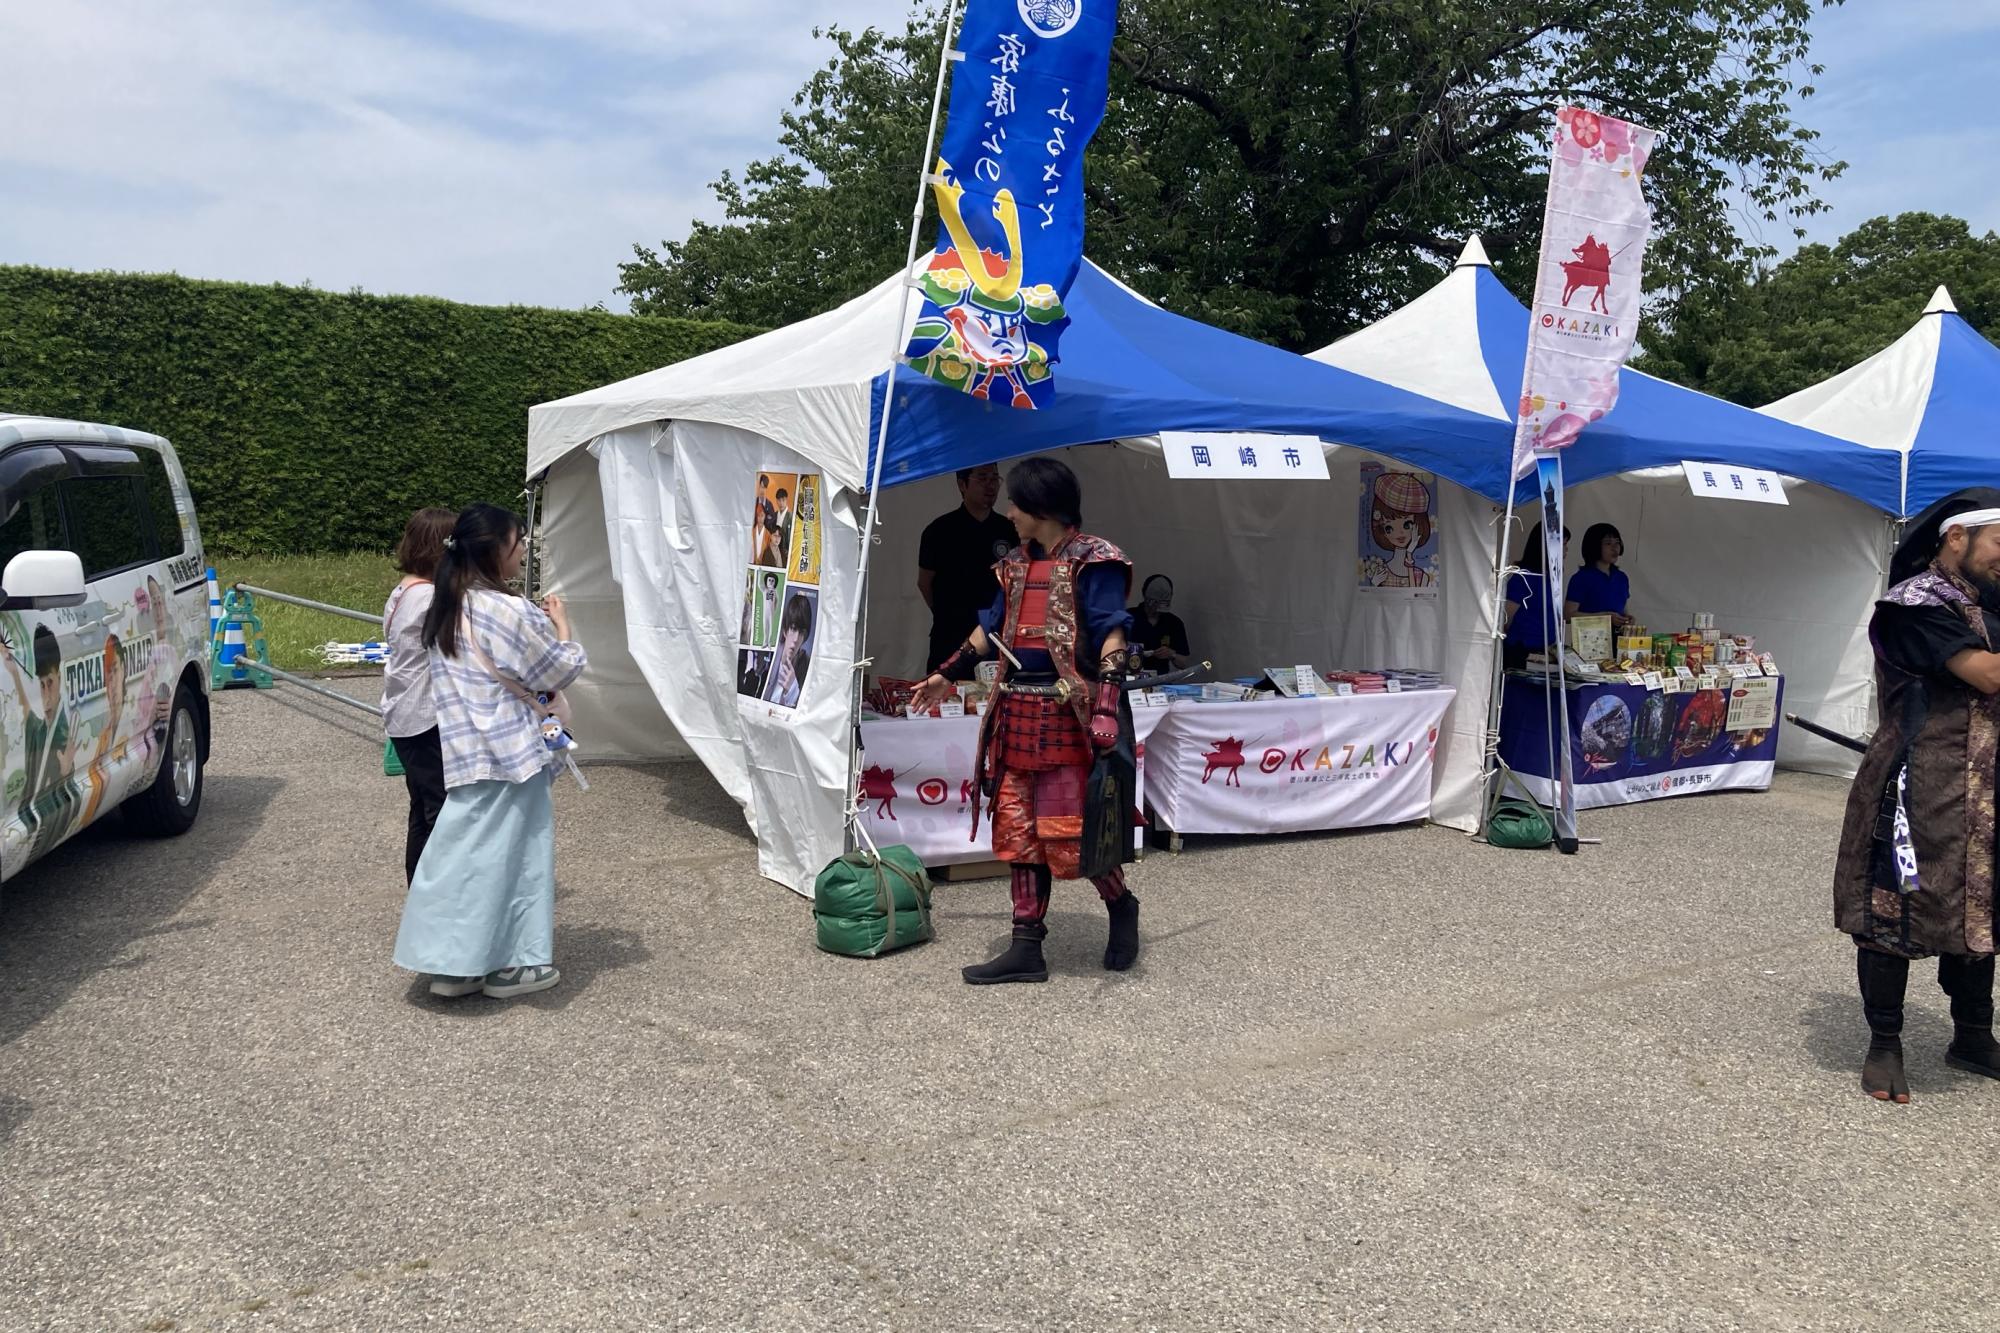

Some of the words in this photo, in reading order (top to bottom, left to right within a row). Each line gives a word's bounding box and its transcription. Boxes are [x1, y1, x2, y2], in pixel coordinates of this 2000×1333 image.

[1541, 313, 1620, 338] OKAZAKI
[1191, 445, 1302, 468] 岡崎市
[1703, 471, 1770, 494] 長野市
[1259, 741, 1413, 774] OKAZAKI
